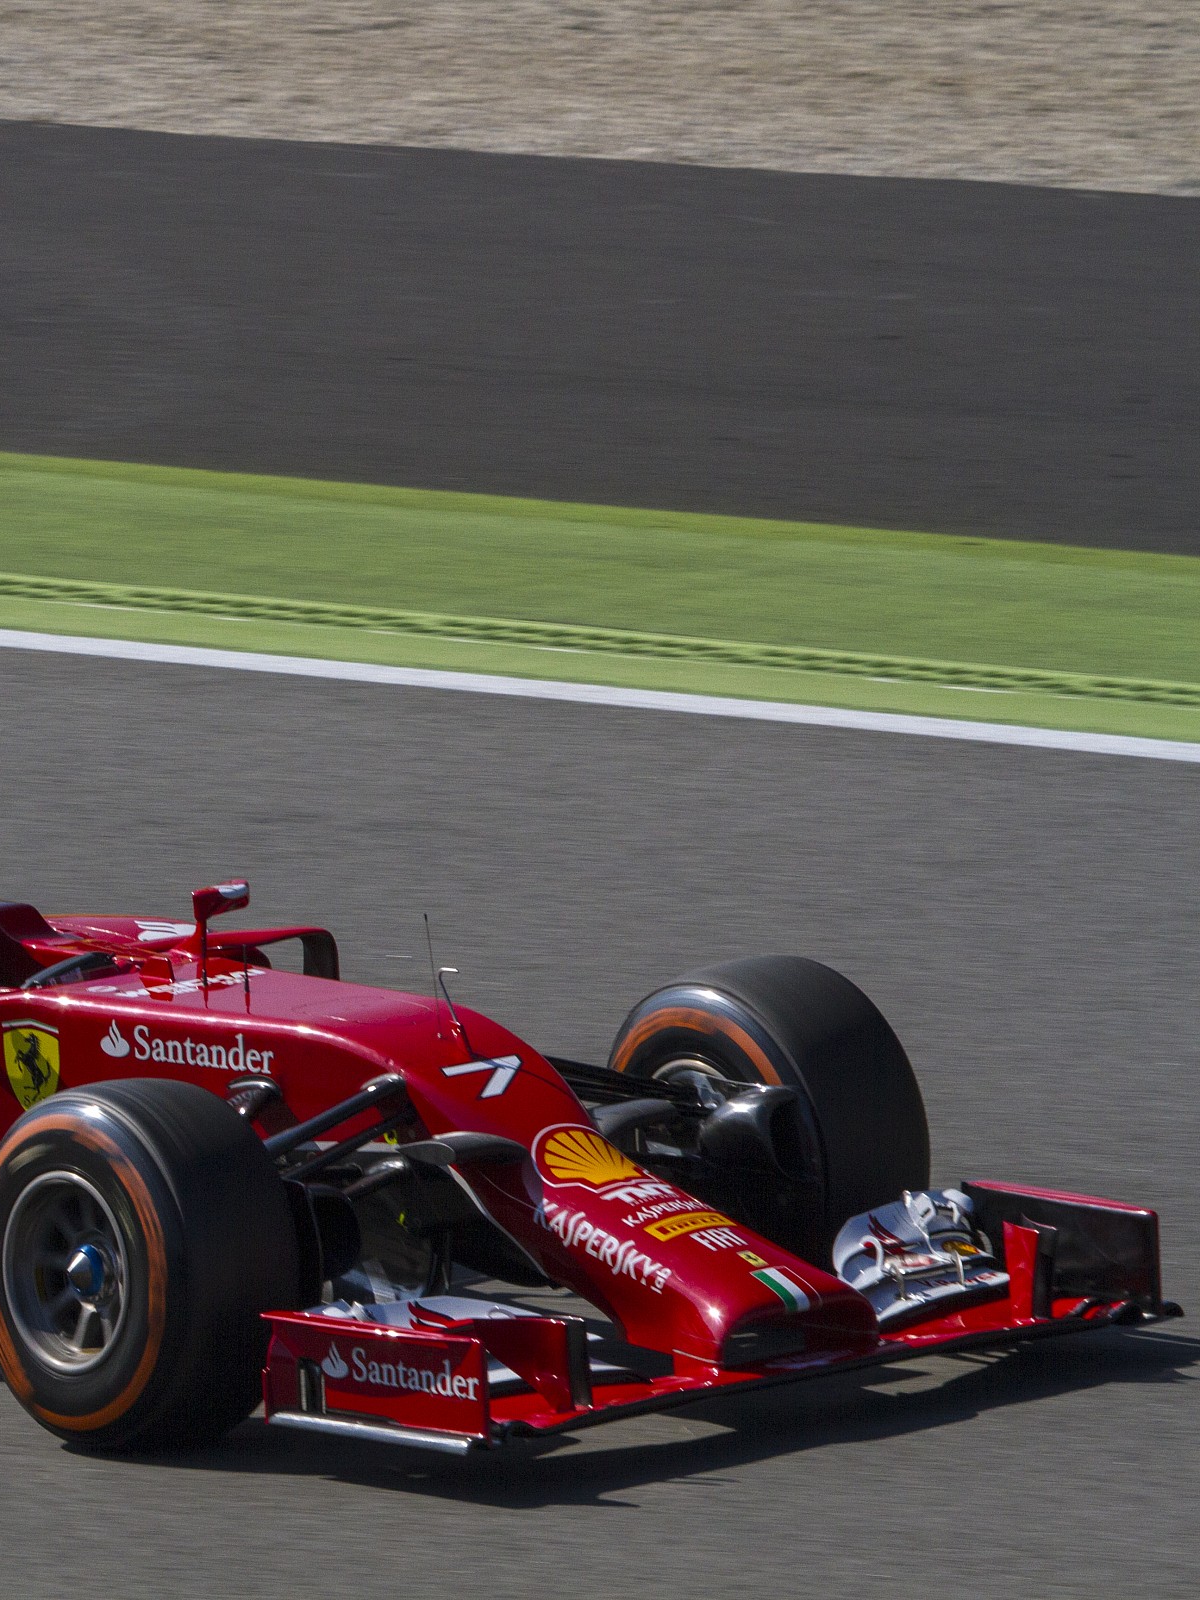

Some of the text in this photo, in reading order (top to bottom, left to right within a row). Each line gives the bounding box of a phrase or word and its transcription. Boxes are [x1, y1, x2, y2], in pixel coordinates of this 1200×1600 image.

[133, 1025, 274, 1075] Santander
[441, 1054, 523, 1099] 7
[533, 1198, 665, 1287] KASPERSKY
[689, 1227, 749, 1252] FIAT
[352, 1347, 480, 1401] Santander
